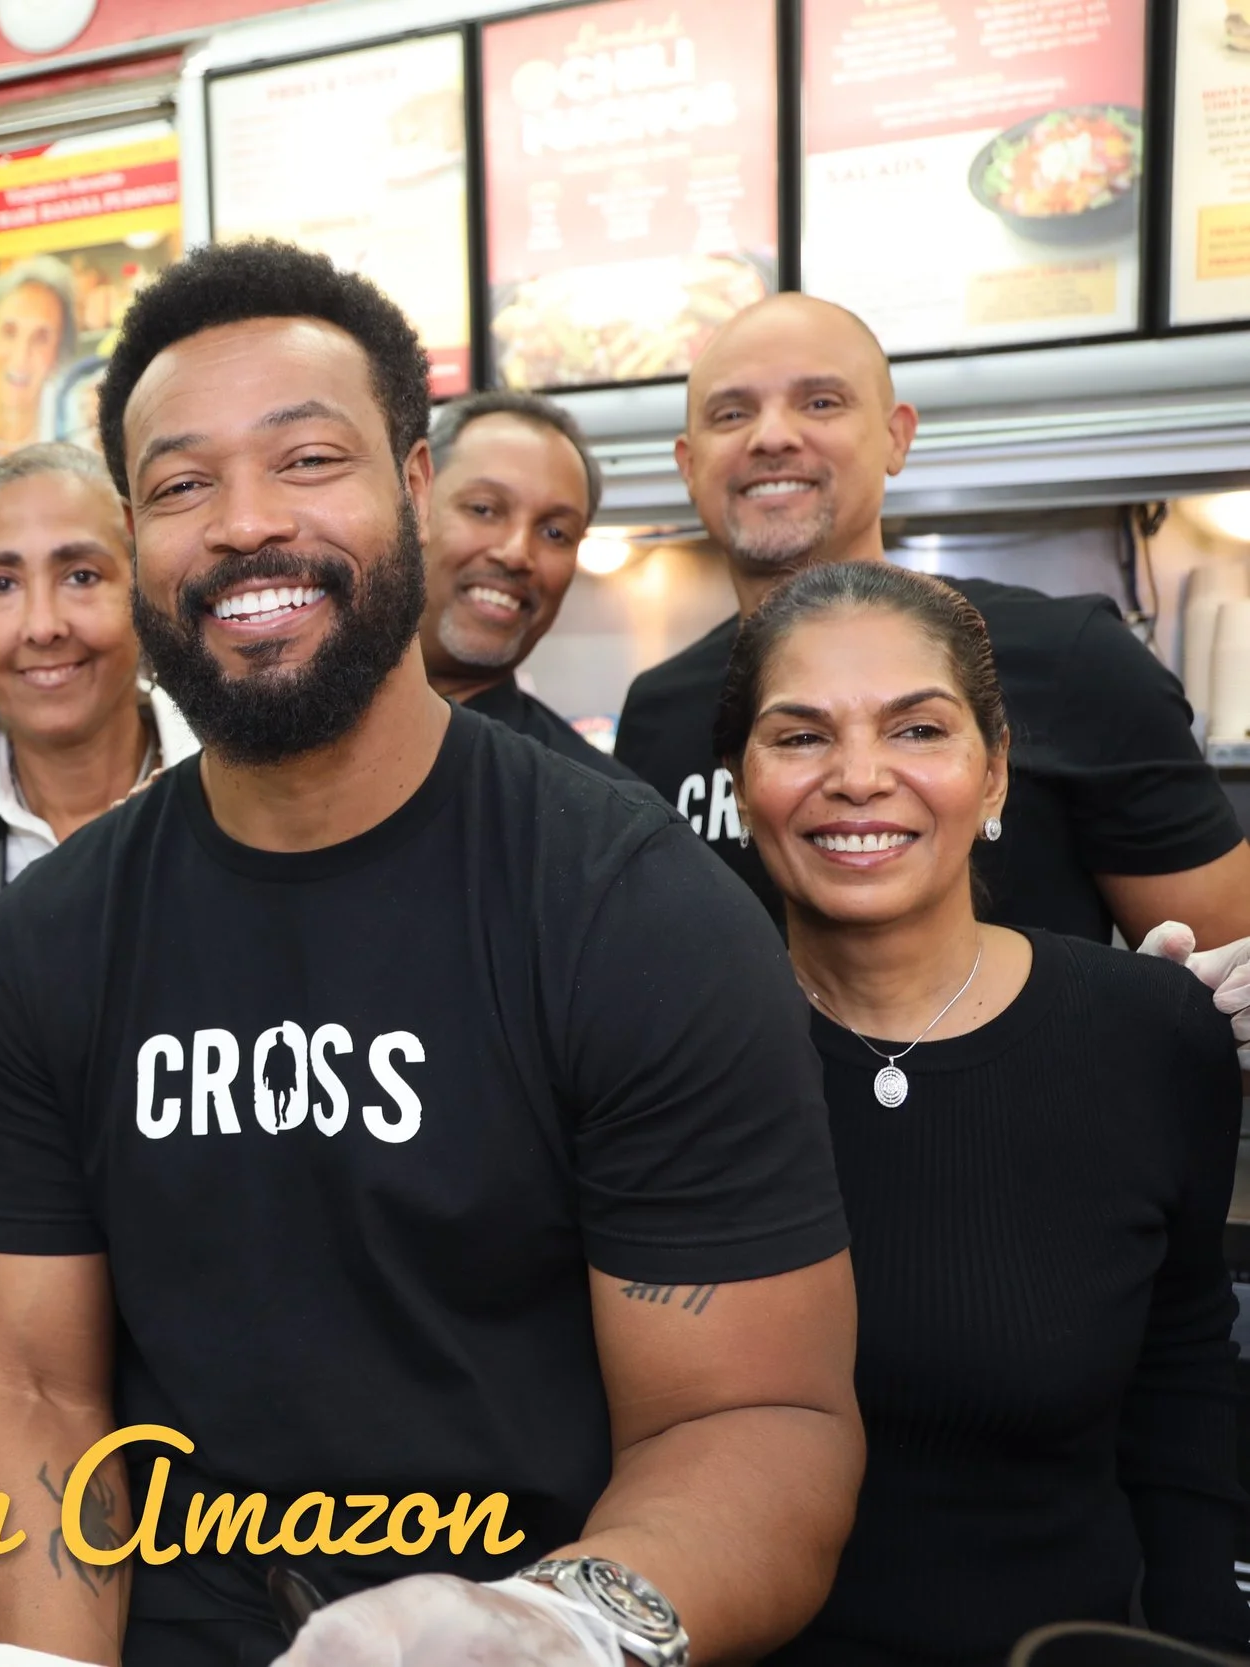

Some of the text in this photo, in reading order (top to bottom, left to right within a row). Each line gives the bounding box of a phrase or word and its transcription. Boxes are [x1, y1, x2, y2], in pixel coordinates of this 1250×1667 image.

[558, 36, 696, 101] CHILI
[825, 156, 928, 185] SALADS
[135, 1020, 426, 1144] CROSS
